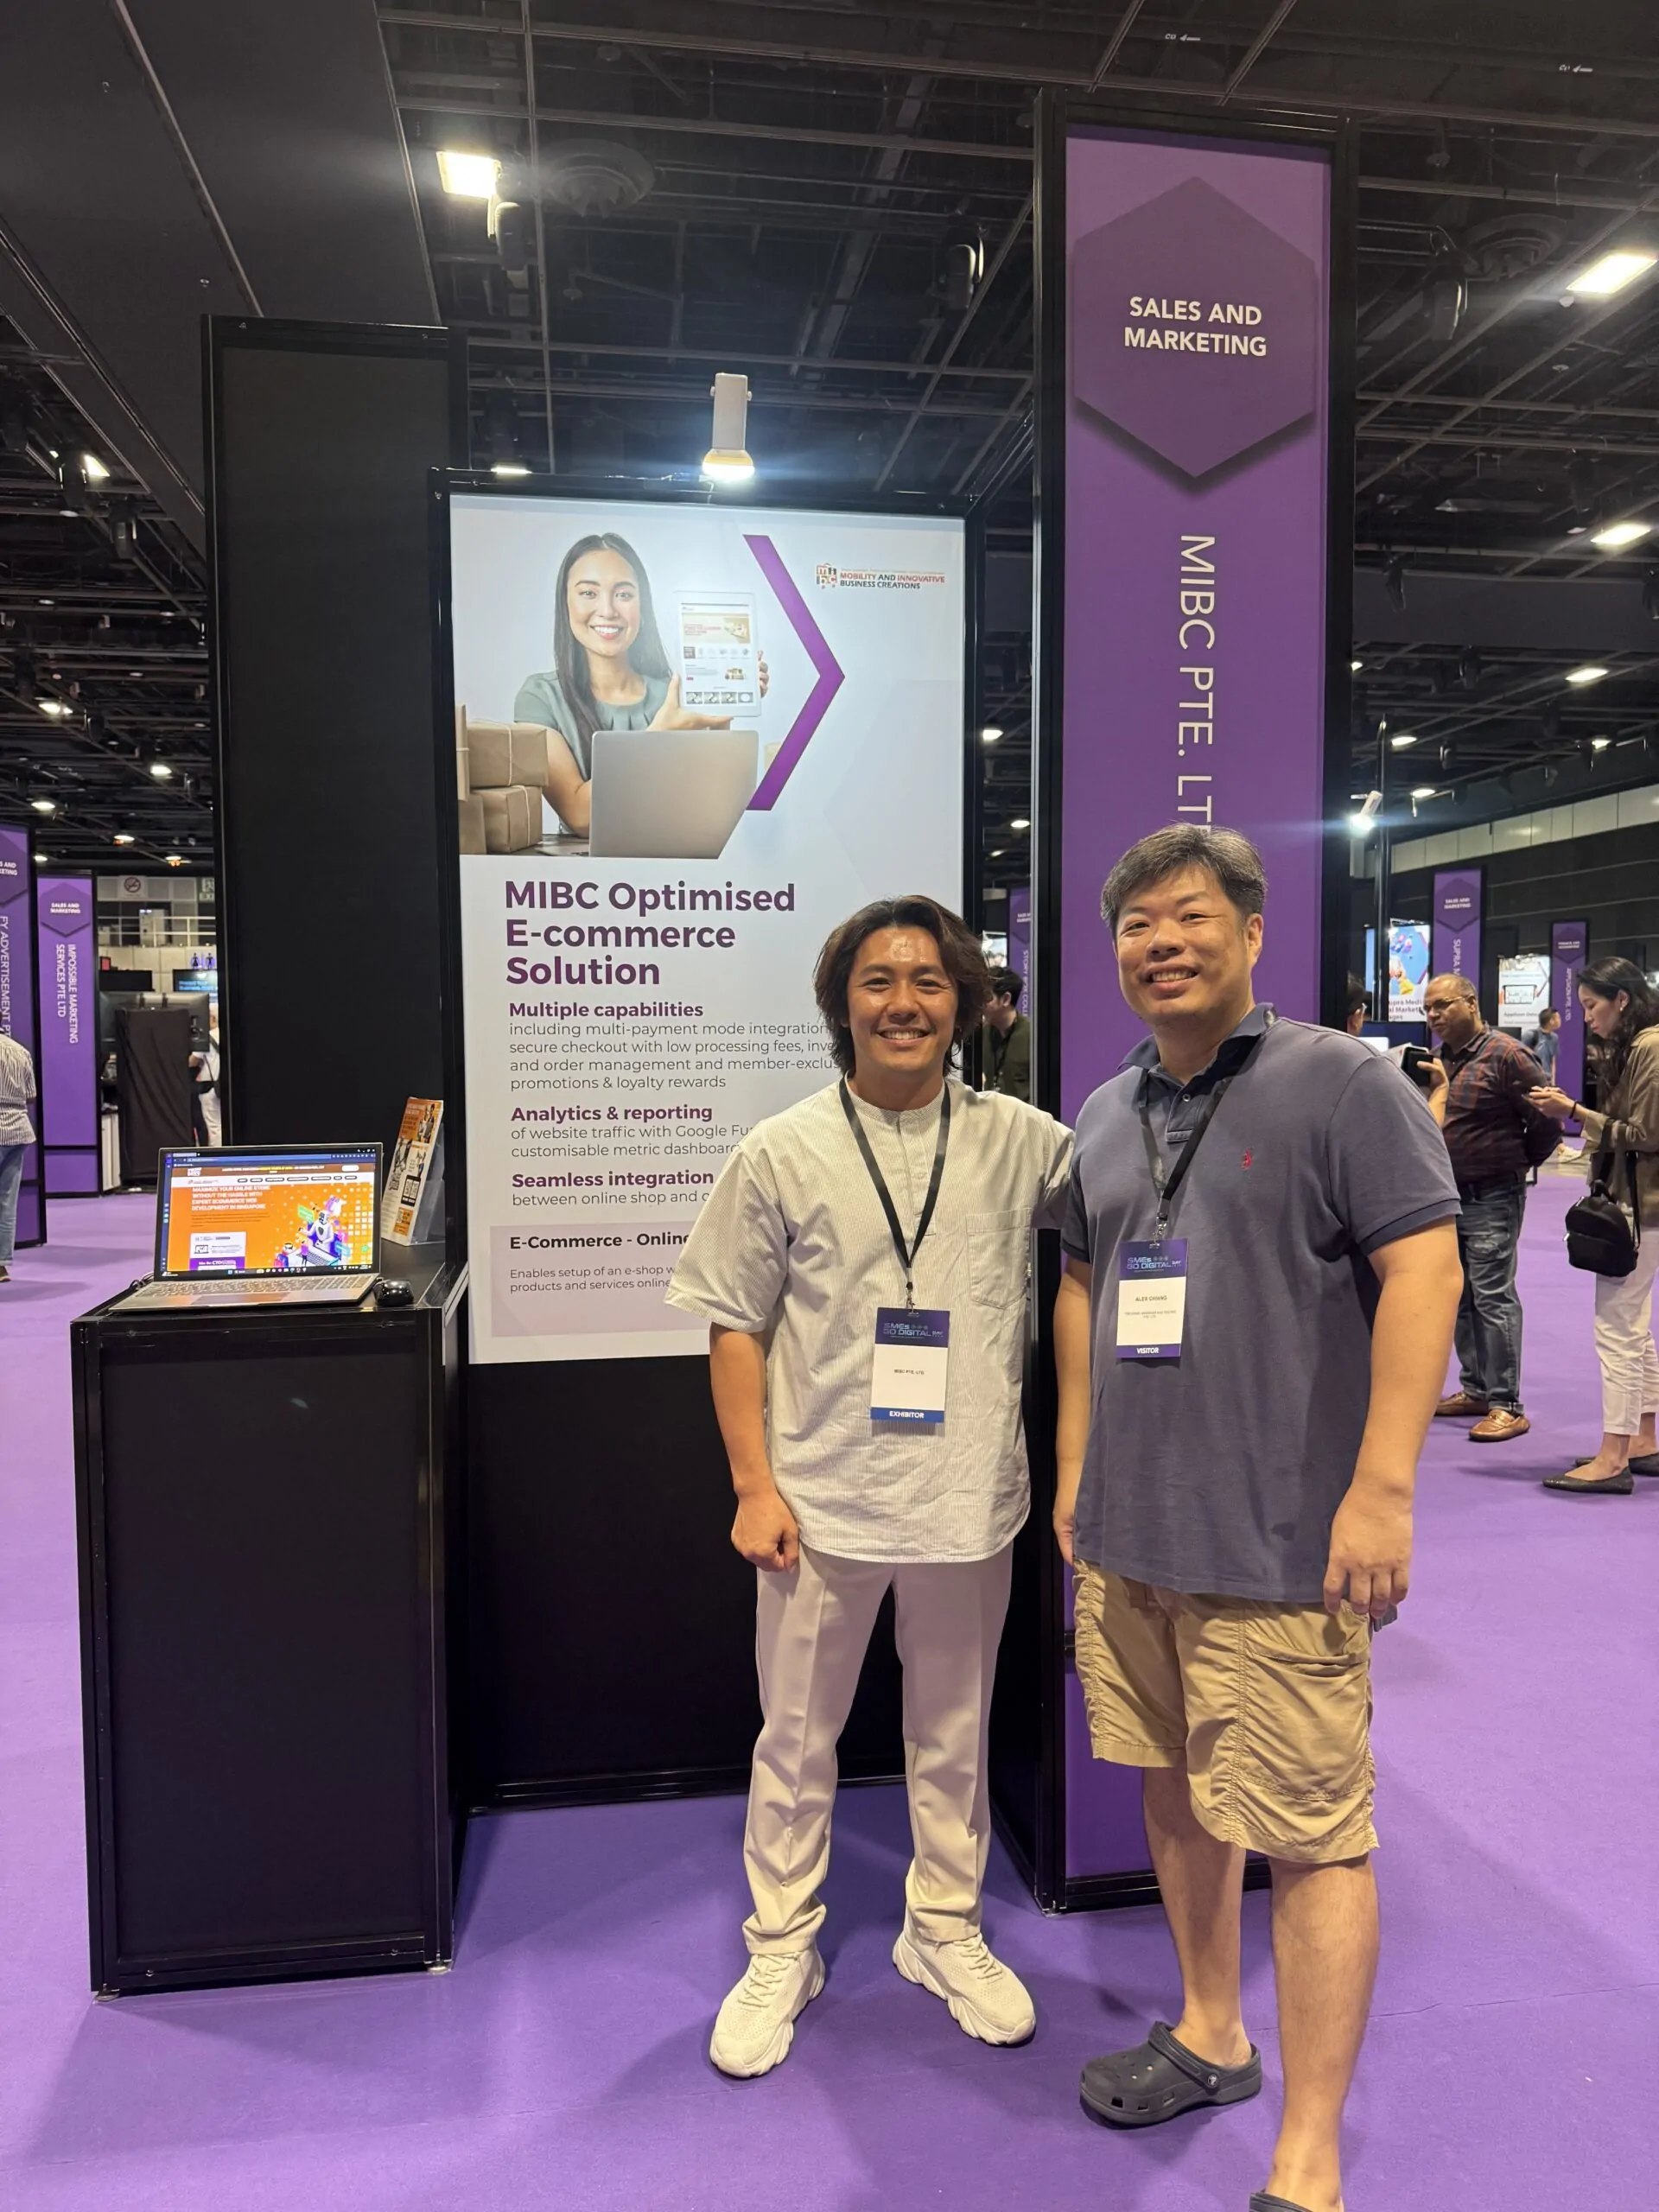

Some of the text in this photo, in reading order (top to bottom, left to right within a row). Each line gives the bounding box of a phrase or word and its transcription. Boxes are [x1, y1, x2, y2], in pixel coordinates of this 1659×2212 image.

[1129, 296, 1262, 326] SALES AND
[1124, 327, 1267, 357] MARKETING
[840, 572, 876, 581] MOBILITY
[897, 575, 945, 583] INNOVATIVE
[1178, 534, 1216, 832] MIBC PTE. LT
[505, 880, 795, 917] MIBC Optimised
[506, 918, 735, 948] E-commerce
[0, 931, 10, 1023] ADVERTISEMENT
[505, 955, 660, 985] Solution
[56, 944, 66, 1018] SERVICES PTE LTD
[67, 944, 79, 1044] IMPOSSIBLE MARKETING
[510, 1001, 703, 1020] Multiple capabilities
[510, 1022, 581, 1037] including
[586, 1022, 698, 1037] multi-payment
[702, 1022, 745, 1034] mode
[510, 1041, 557, 1053] secure
[562, 1040, 628, 1053] checkout
[631, 1040, 663, 1052] with
[667, 1040, 691, 1052] low
[696, 1039, 769, 1054] processing
[773, 1039, 804, 1053] fees,
[510, 1059, 539, 1071] and
[543, 1058, 584, 1071] order
[589, 1059, 691, 1073] management
[696, 1058, 722, 1070] and
[511, 1075, 726, 1091] promotions & loyalty rewards
[511, 1104, 713, 1124] Analytics & reporting
[512, 1124, 753, 1140] of website traffic with Google Fu
[512, 1144, 608, 1157] customisable
[613, 1142, 660, 1155] metric
[512, 1170, 714, 1189] Seamless integration
[512, 1194, 577, 1206] between
[582, 1192, 627, 1205] online
[631, 1191, 666, 1205] shop
[671, 1191, 697, 1203] and
[510, 1236, 622, 1249] E-Commerce
[510, 1268, 556, 1279] Enables
[558, 1267, 591, 1280] setup
[594, 1267, 605, 1277] of
[625, 1265, 664, 1277] e-shop
[510, 1281, 562, 1294] products
[565, 1280, 587, 1290] and
[589, 1279, 634, 1289] services
[889, 1410, 925, 1419] EXHIBITOR
